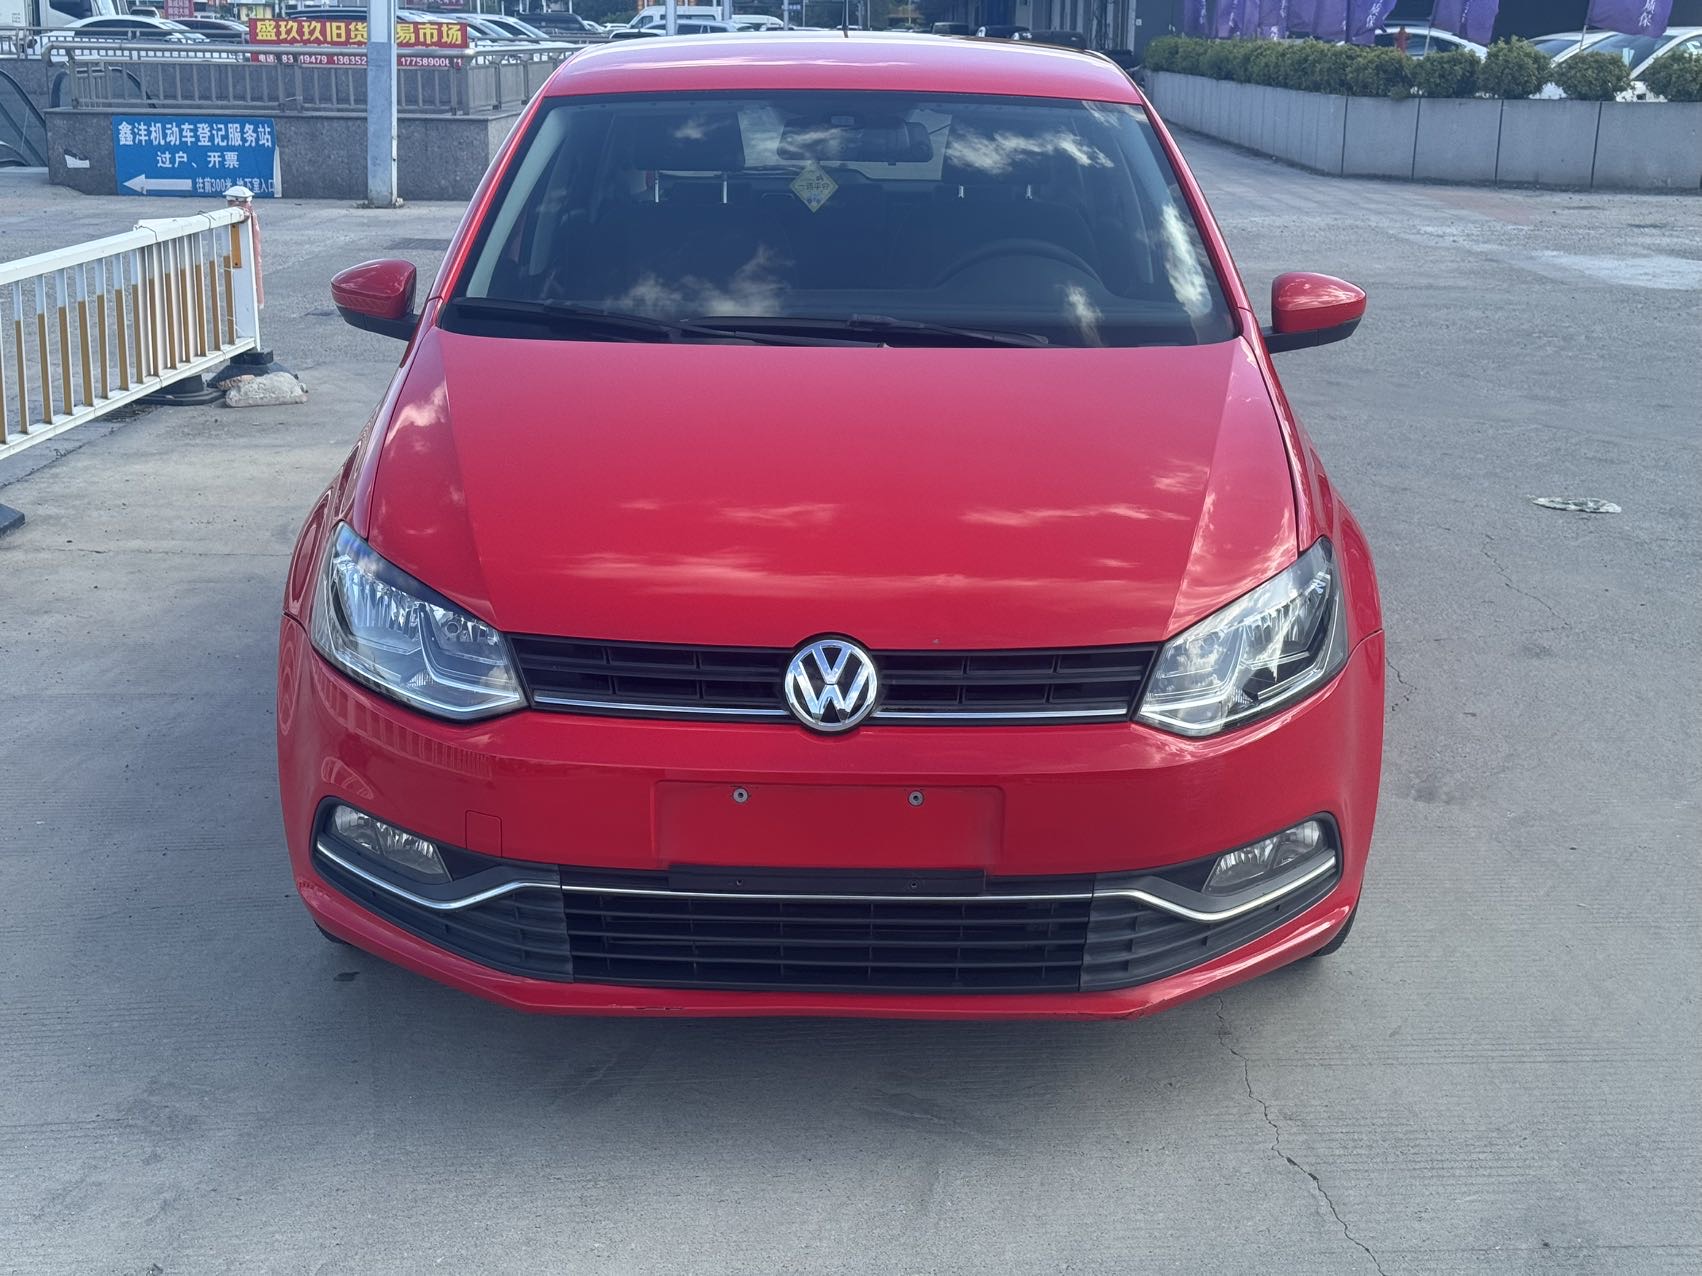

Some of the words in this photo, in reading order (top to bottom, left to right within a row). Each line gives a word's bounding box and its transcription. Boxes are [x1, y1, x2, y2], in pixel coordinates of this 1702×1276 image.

[256, 20, 462, 44] 盛玖玖旧货易市场
[282, 54, 327, 65] 8319479
[118, 121, 272, 148] 鑫沣机动车登记服务站
[157, 151, 239, 169] 过户、开票
[789, 643, 872, 728] VW
